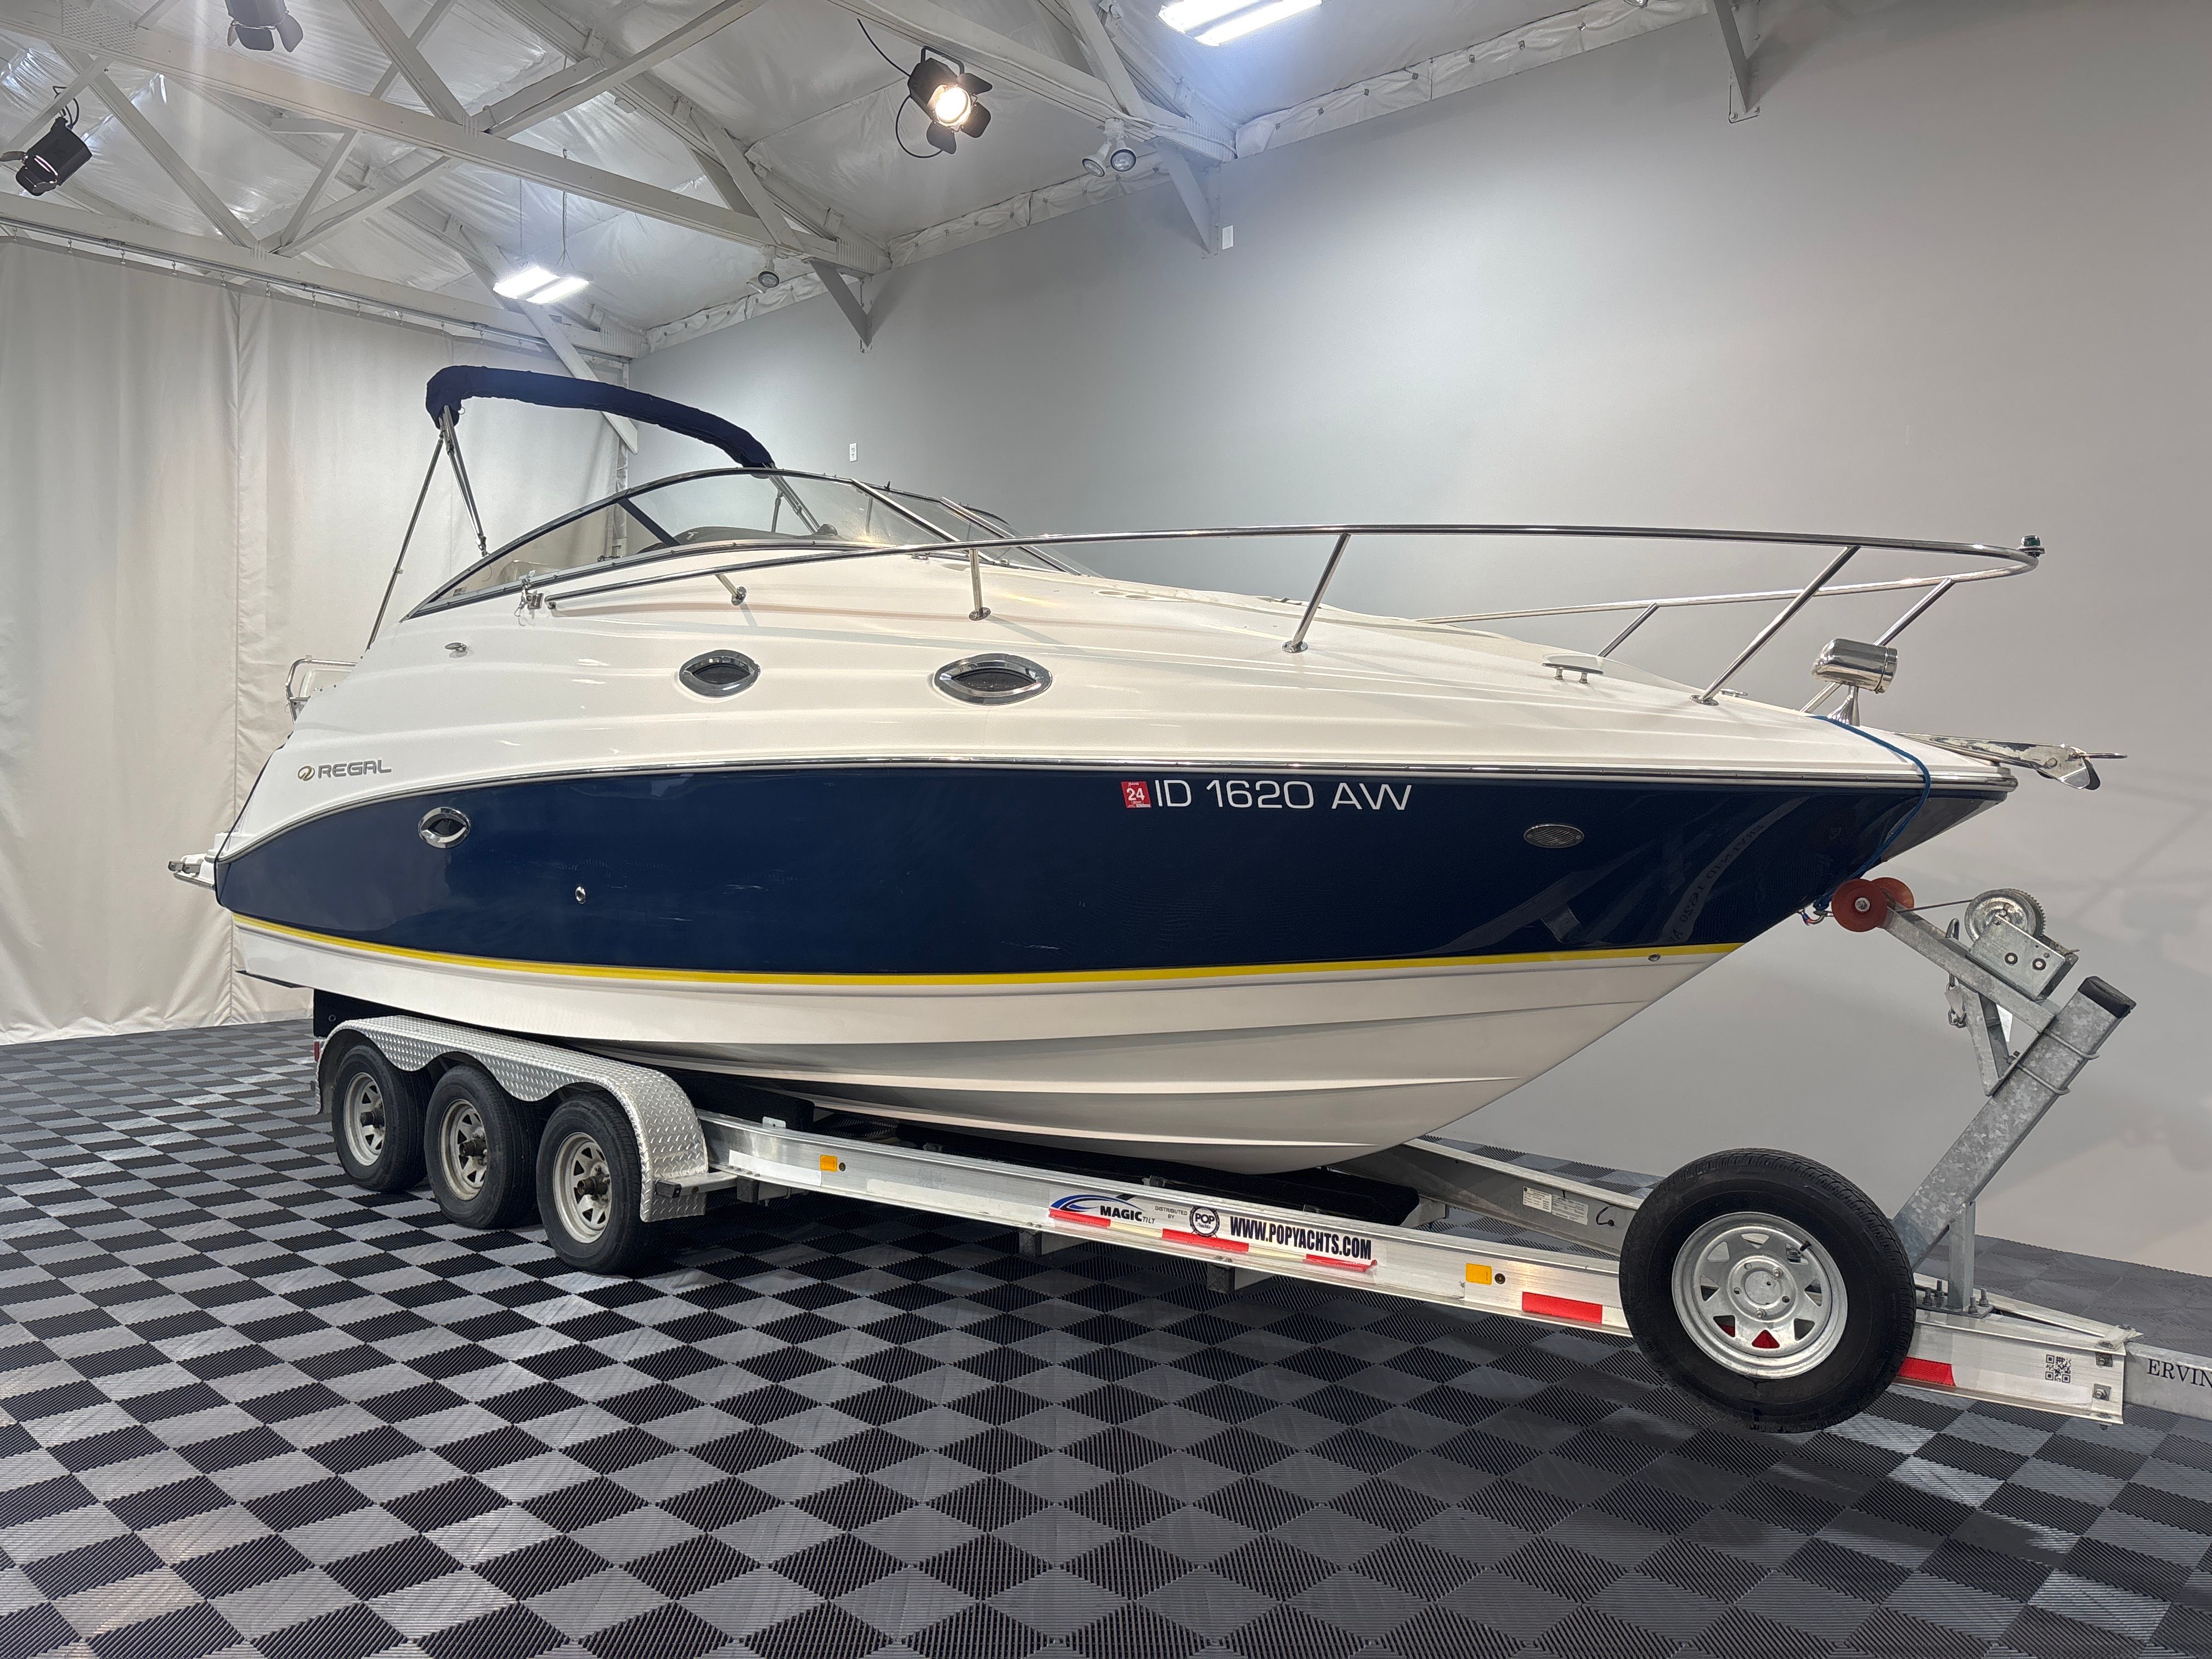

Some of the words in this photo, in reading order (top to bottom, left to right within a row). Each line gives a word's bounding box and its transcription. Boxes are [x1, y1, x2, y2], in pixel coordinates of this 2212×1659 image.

[318, 760, 392, 778] REGAL
[1126, 788, 1145, 800] 24
[1155, 780, 1192, 806] ID
[1206, 780, 1314, 809] 1620
[1331, 782, 1412, 810] AW
[1101, 1205, 1142, 1222] MAGIC
[1155, 1206, 1188, 1215] DISTRIBUTED
[1195, 1213, 1215, 1224] POP
[1230, 1216, 1372, 1260] WWW.POPYACHTS.COM
[2147, 1358, 2212, 1389] ERVIN
